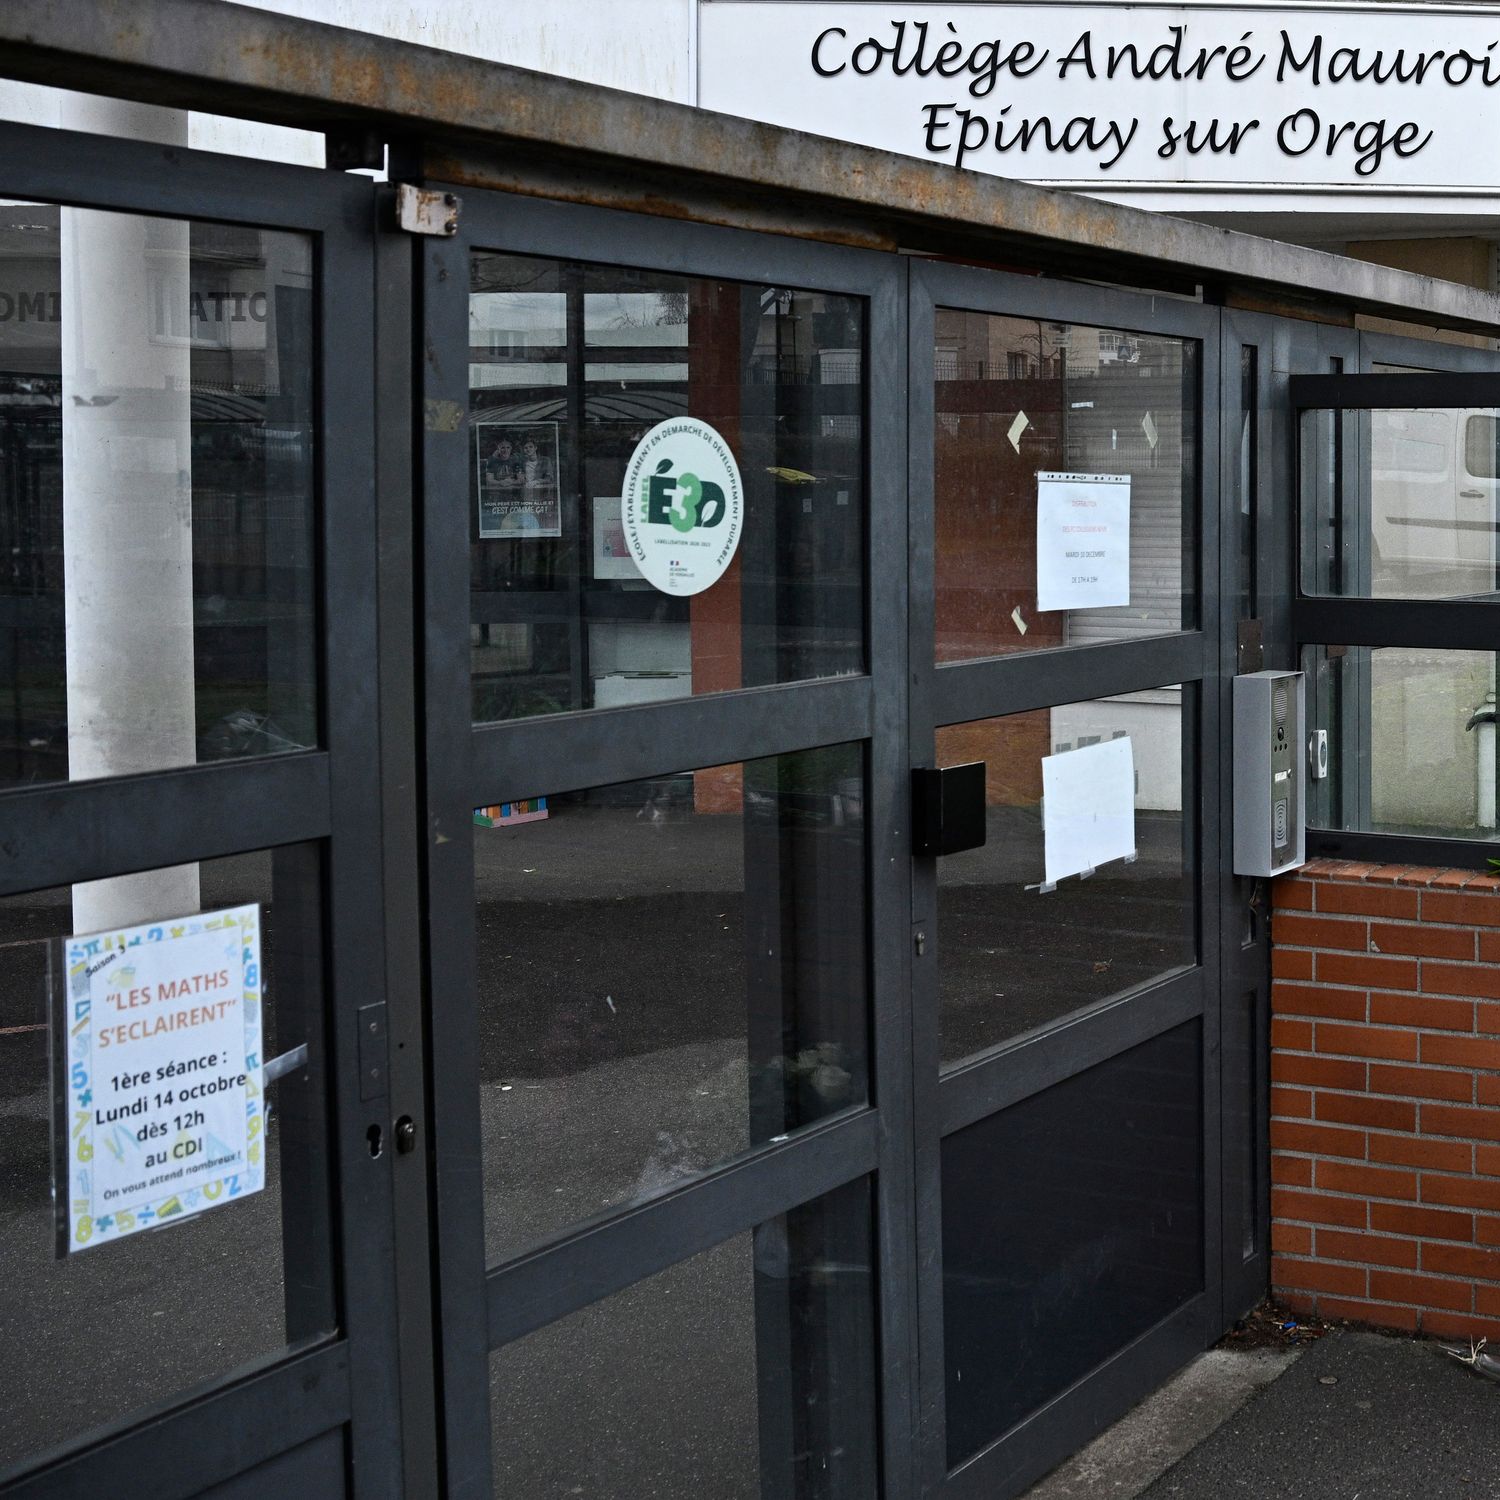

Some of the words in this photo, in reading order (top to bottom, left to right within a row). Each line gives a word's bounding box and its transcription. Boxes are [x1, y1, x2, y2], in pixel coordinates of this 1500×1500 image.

[811, 20, 1050, 97] Collège
[1056, 25, 1266, 82] André
[921, 103, 1138, 169] Epinay
[1157, 116, 1260, 159] sur
[1276, 108, 1433, 176] Orge
[640, 475, 649, 523] LABEL
[650, 435, 662, 447] EN
[703, 432, 713, 444] DE
[717, 523, 738, 565] DURABLE
[85, 953, 116, 978] Saison
[158, 969, 229, 1001] MATHS
[111, 1071, 151, 1092] 1ère
[156, 1053, 218, 1081] séance
[95, 1096, 148, 1125] Lundi
[154, 1090, 174, 1109] 14
[179, 1074, 247, 1102] octobre
[137, 1122, 168, 1142] dès
[174, 1110, 205, 1131] 12h
[145, 1151, 167, 1168] au
[173, 1137, 202, 1159] CDI
[104, 1189, 119, 1200] On
[122, 1181, 146, 1195] vous
[149, 1168, 183, 1186] attend
[186, 1153, 237, 1175] nombreux
